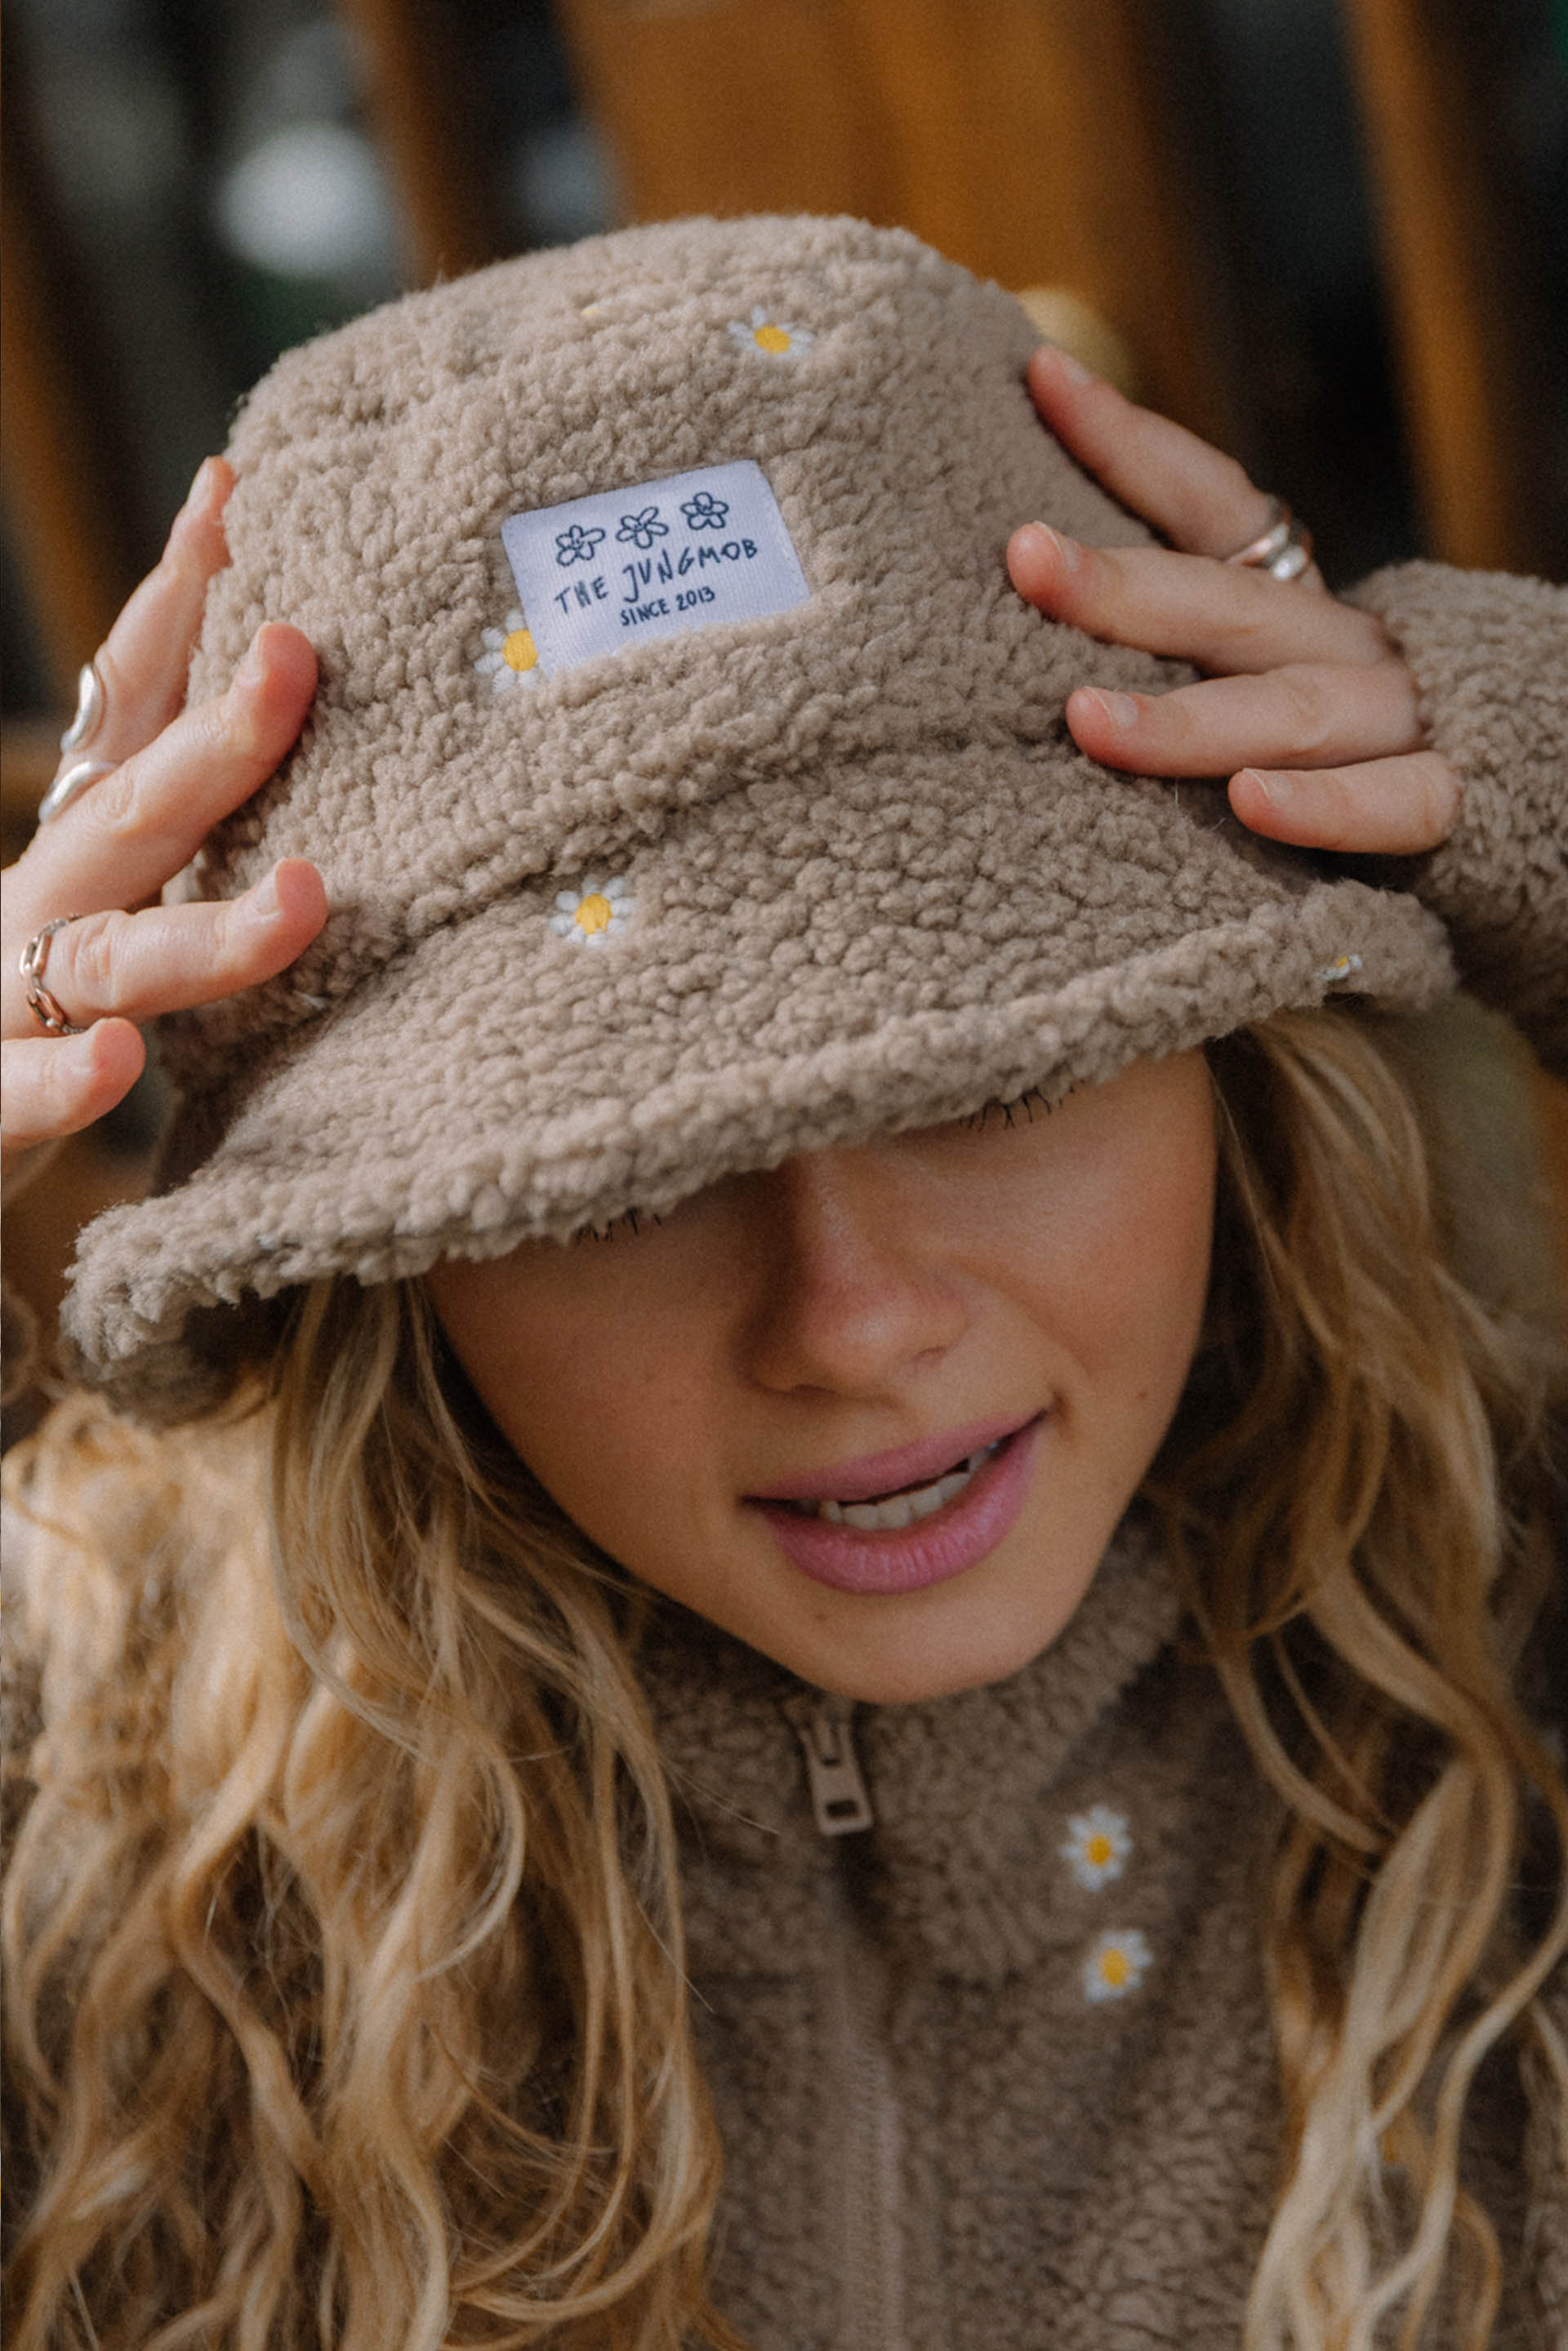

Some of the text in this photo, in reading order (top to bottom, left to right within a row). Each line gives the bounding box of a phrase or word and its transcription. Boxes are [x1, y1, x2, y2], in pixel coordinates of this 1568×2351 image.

[555, 577, 608, 614] THE
[621, 586, 715, 626] SINCE 2013
